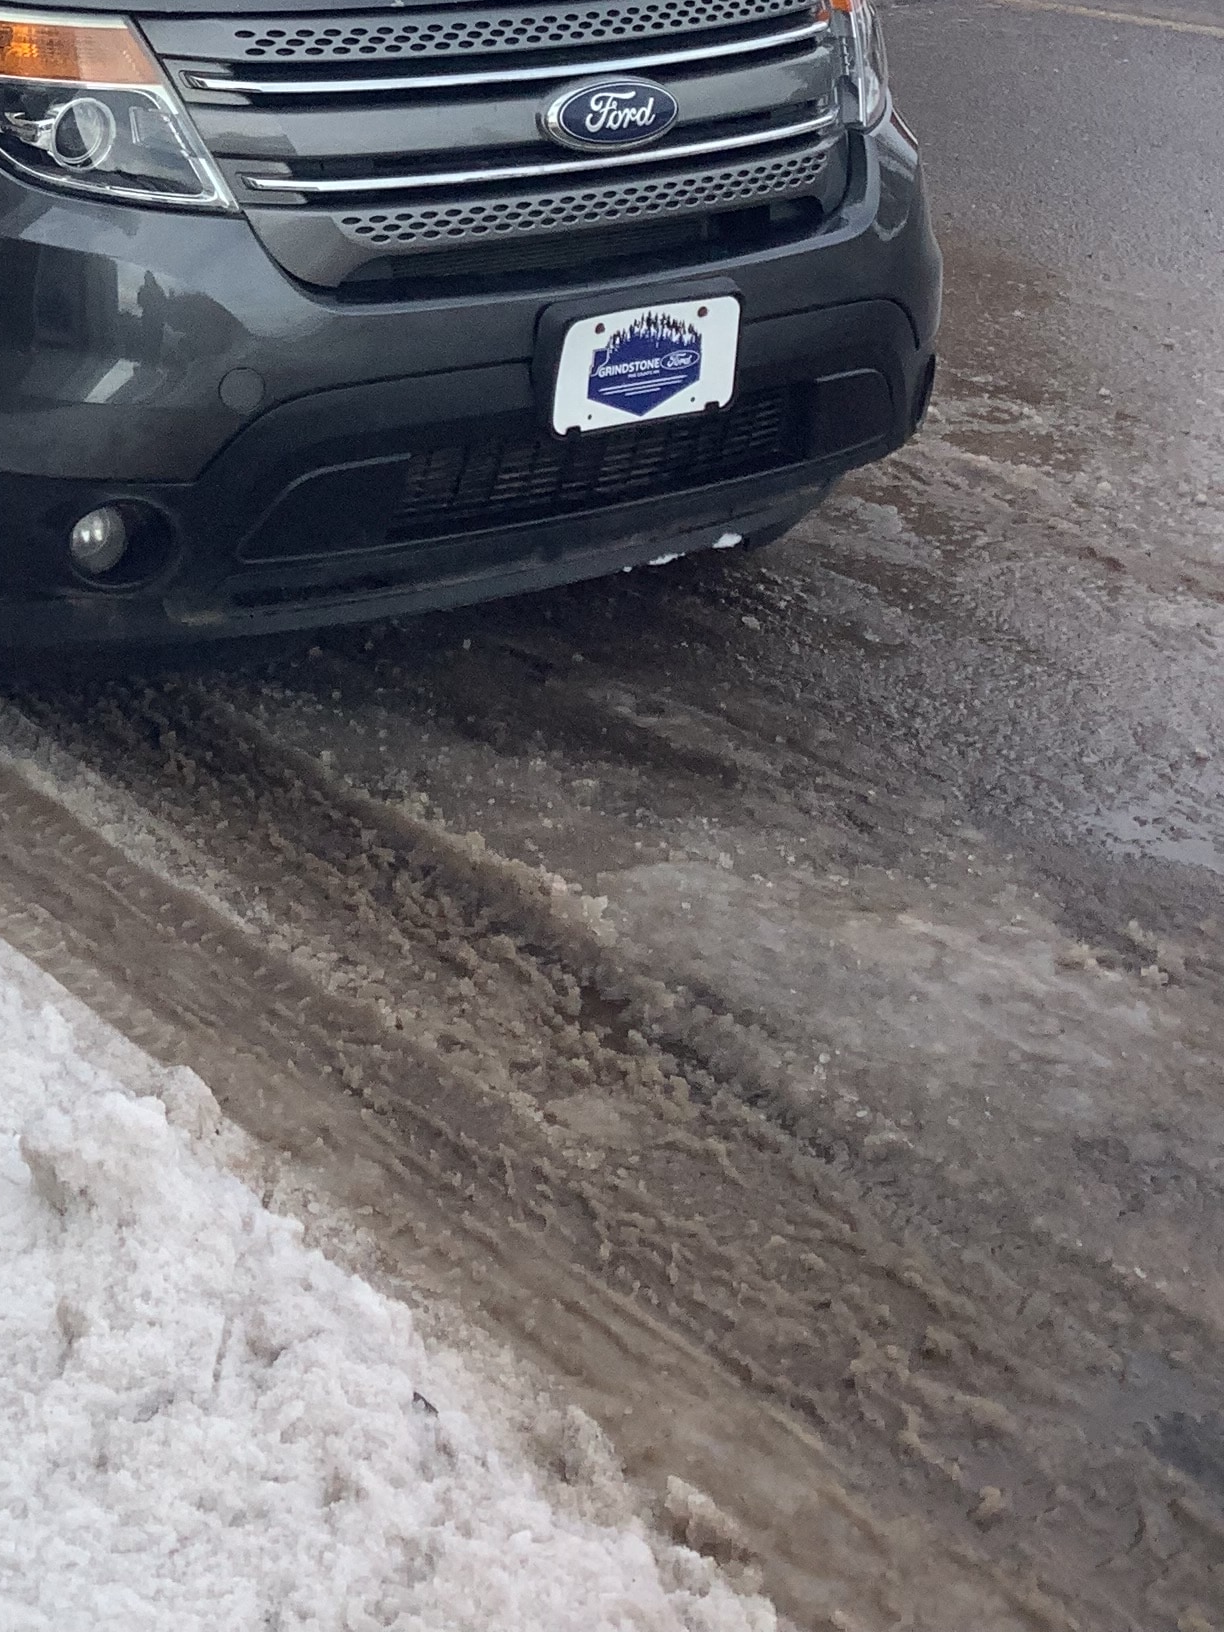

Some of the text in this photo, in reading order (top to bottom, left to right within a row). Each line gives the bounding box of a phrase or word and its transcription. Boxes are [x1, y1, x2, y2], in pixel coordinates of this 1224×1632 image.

[585, 90, 656, 133] Ford
[598, 357, 661, 378] GRINDSTONE
[667, 352, 693, 367] Ford
